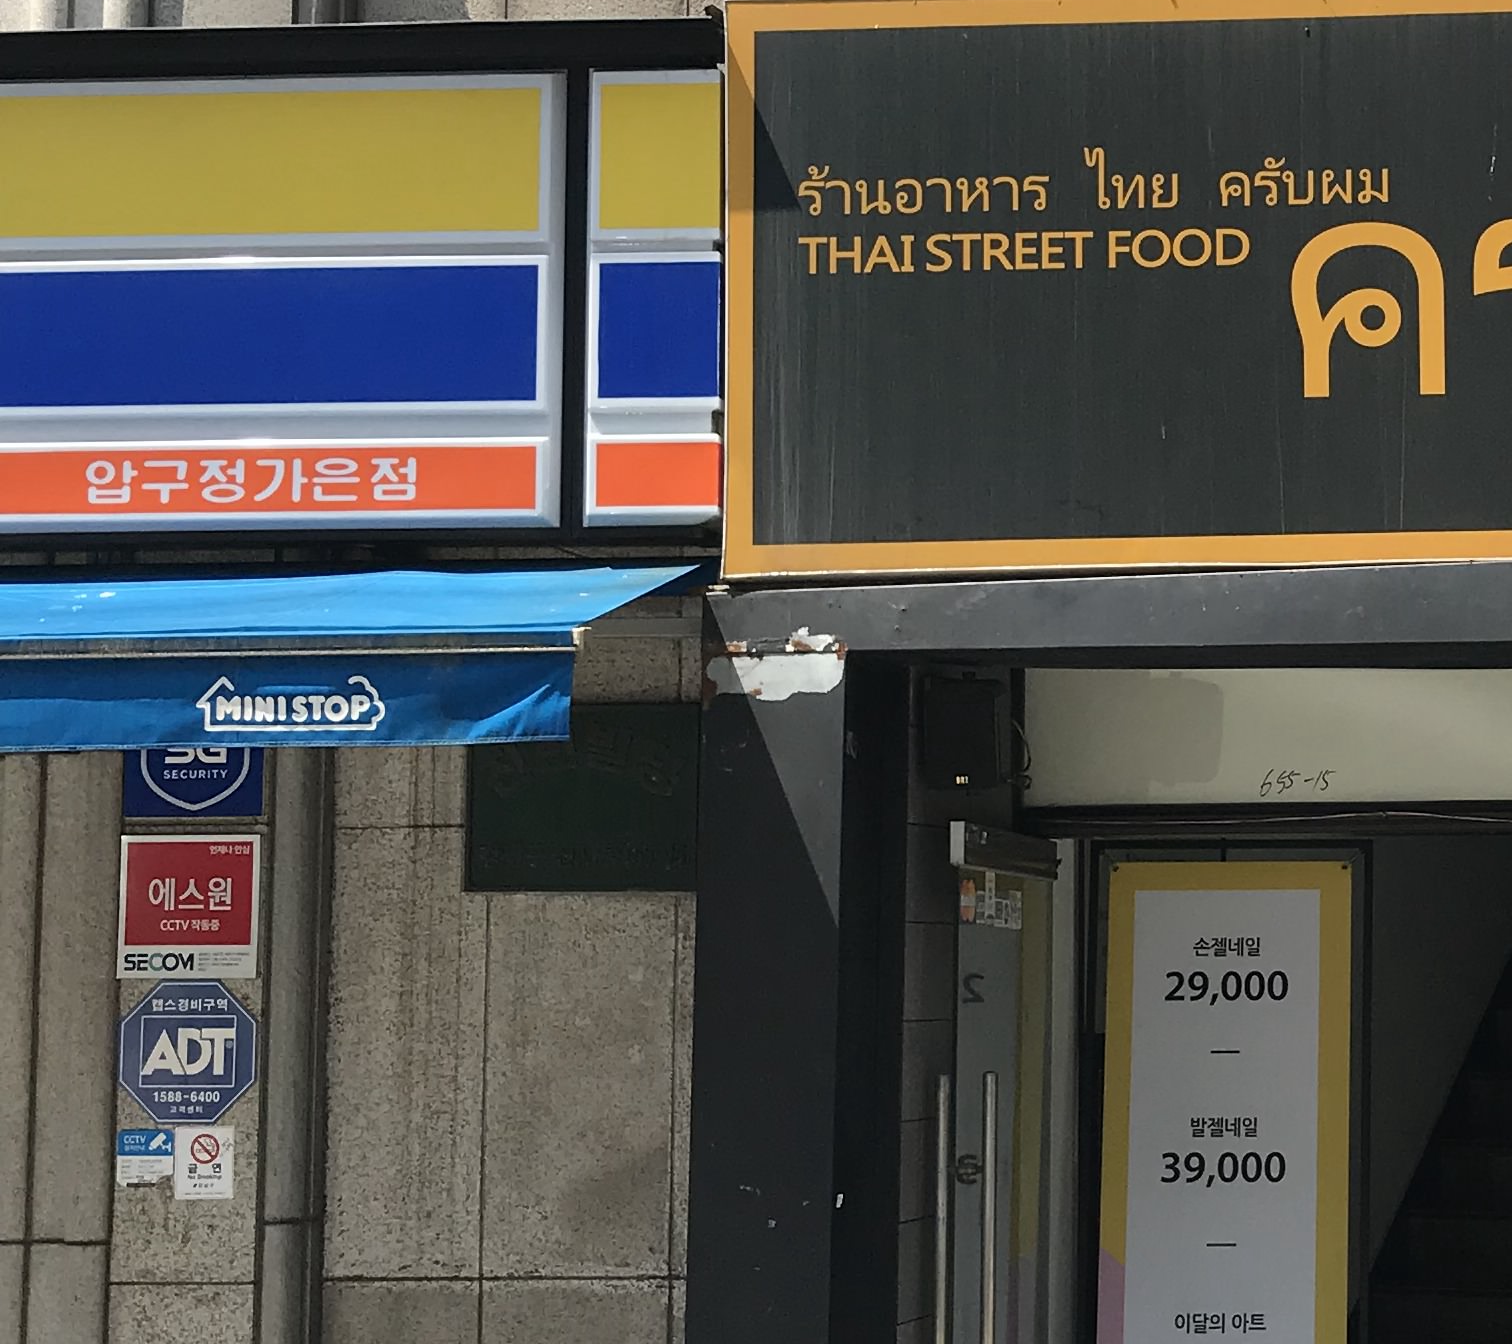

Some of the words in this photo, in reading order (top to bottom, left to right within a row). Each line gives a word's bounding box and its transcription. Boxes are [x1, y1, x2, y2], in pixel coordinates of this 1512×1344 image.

[798, 165, 1050, 216] ร้านอาหาร
[1084, 147, 1180, 209] ไทย
[1220, 157, 1390, 207] ครับผม
[798, 235, 914, 275] THAI
[925, 230, 1093, 272] STREET
[1107, 227, 1251, 269] FOOD
[84, 456, 419, 505] 압구정가은점
[163, 769, 229, 780] SECURITY
[148, 876, 233, 911] 에스원
[160, 919, 190, 932] CCTV
[1193, 937, 1261, 957] 손젤네일
[123, 952, 195, 972] SECOM
[1164, 970, 1289, 1006] 29,000
[151, 997, 229, 1012] 캡스경비구역
[140, 1027, 236, 1076] ADT
[152, 1090, 221, 1103] 1588-6400
[1190, 1116, 1259, 1138] 발젤네일
[123, 1134, 147, 1145] CCTV
[1160, 1151, 1287, 1188] 39,000
[1174, 1313, 1226, 1334] 이달의
[1231, 1313, 1267, 1333] 아트
